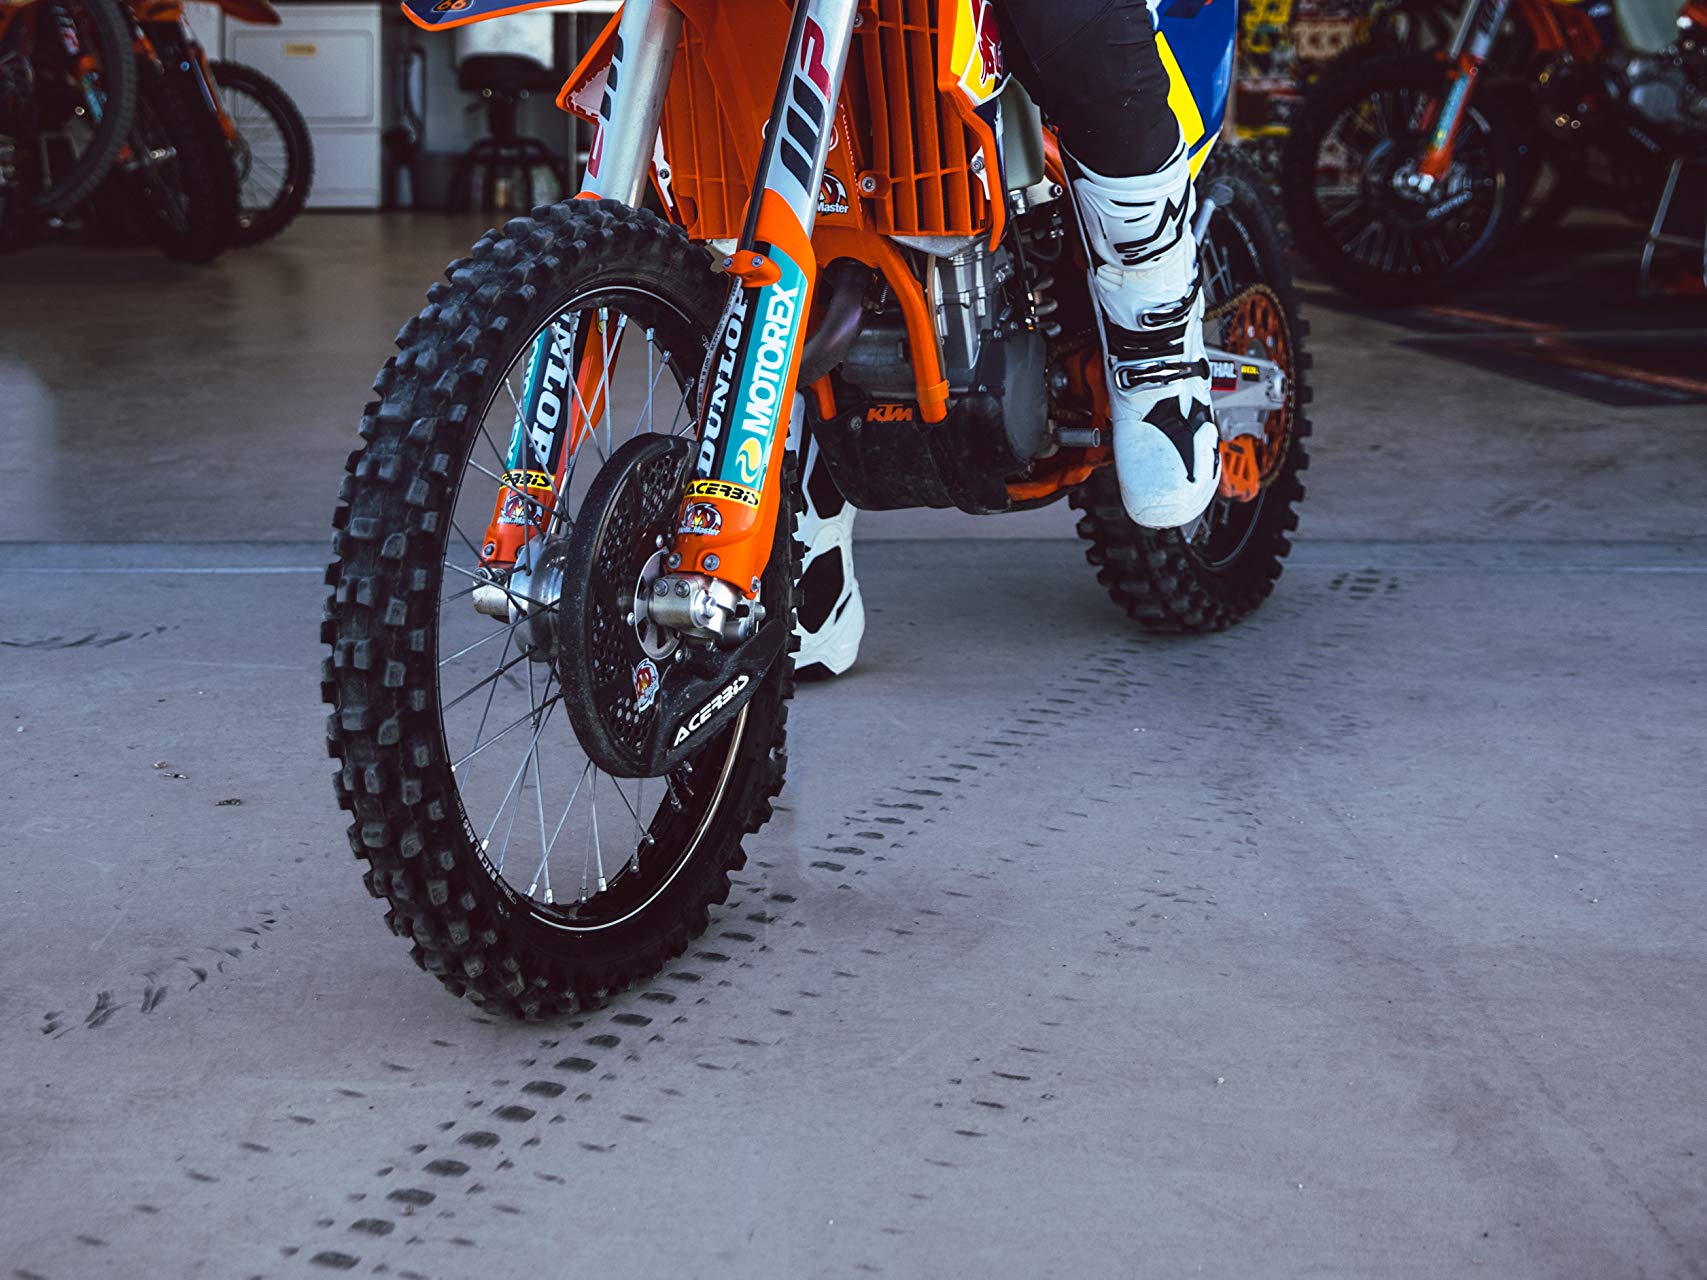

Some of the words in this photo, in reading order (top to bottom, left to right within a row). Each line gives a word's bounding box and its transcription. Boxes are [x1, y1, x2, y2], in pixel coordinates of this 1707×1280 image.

[697, 286, 749, 478] DUNLOP
[742, 283, 799, 437] MOTOREX
[1209, 361, 1237, 378] THAL
[866, 404, 913, 422] KTM
